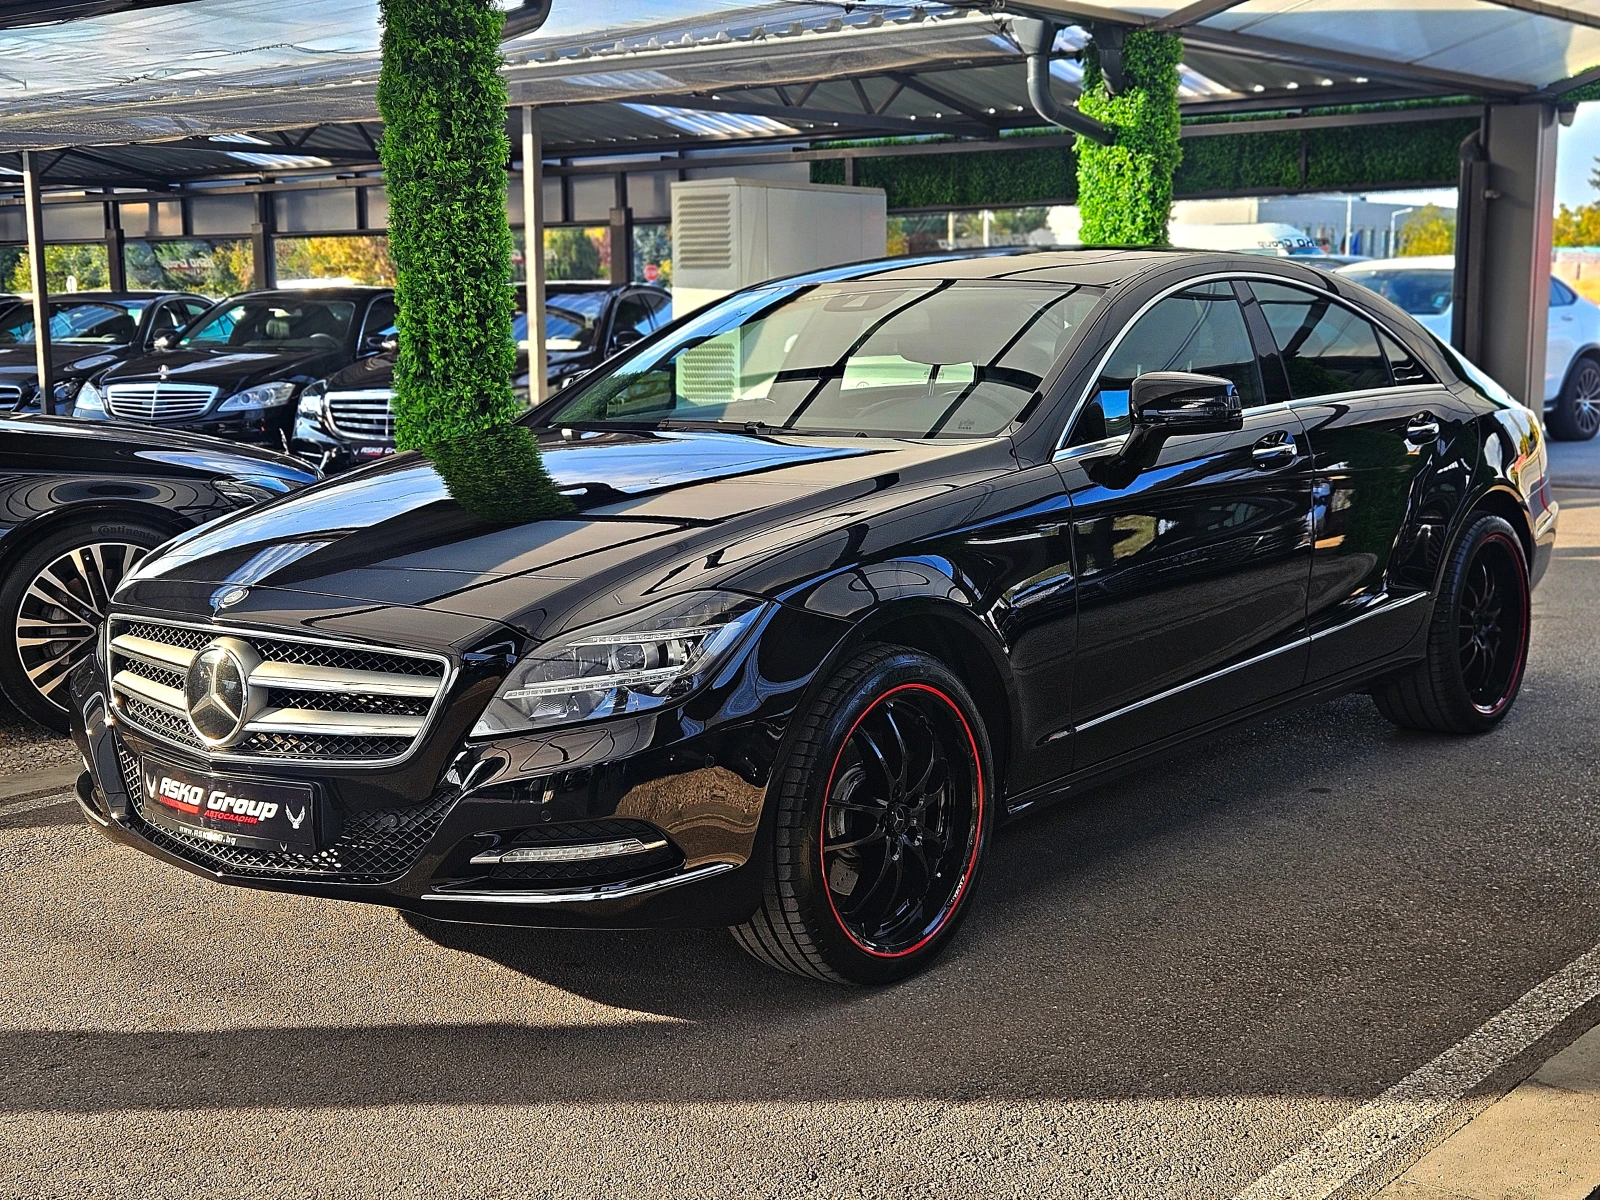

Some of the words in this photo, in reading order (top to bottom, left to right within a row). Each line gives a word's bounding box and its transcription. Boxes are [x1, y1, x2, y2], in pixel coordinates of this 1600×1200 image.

[97, 525, 161, 542] Continental
[159, 776, 204, 805] ASKO
[207, 790, 279, 821] Group
